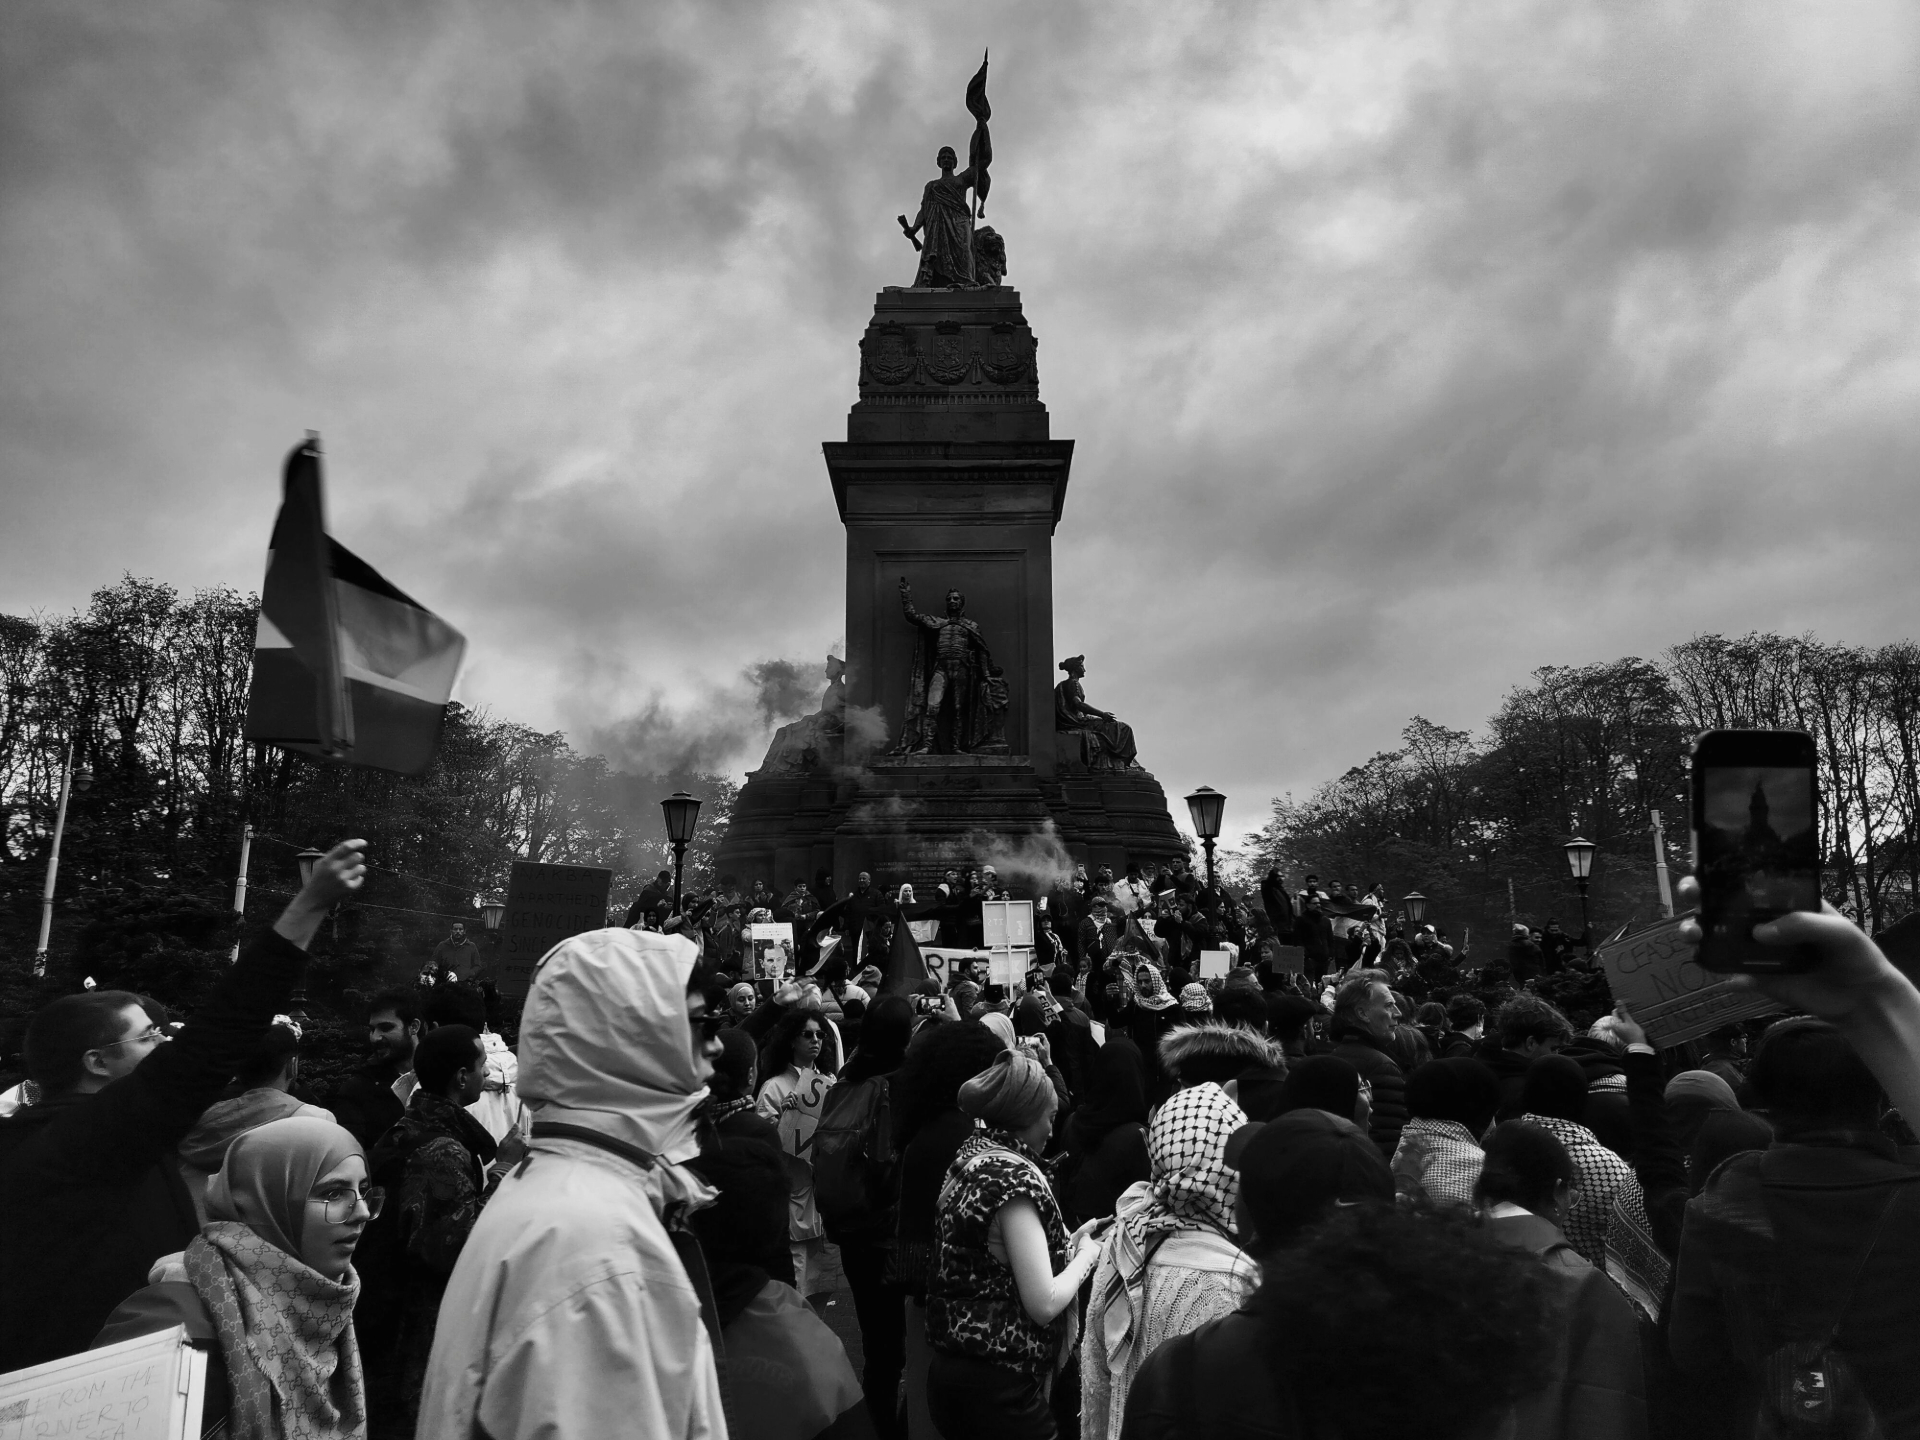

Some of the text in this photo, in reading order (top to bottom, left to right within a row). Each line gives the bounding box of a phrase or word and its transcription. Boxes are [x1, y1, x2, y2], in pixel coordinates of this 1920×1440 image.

[32, 1363, 165, 1426] FROM THE
[121, 1395, 149, 1416] TO
